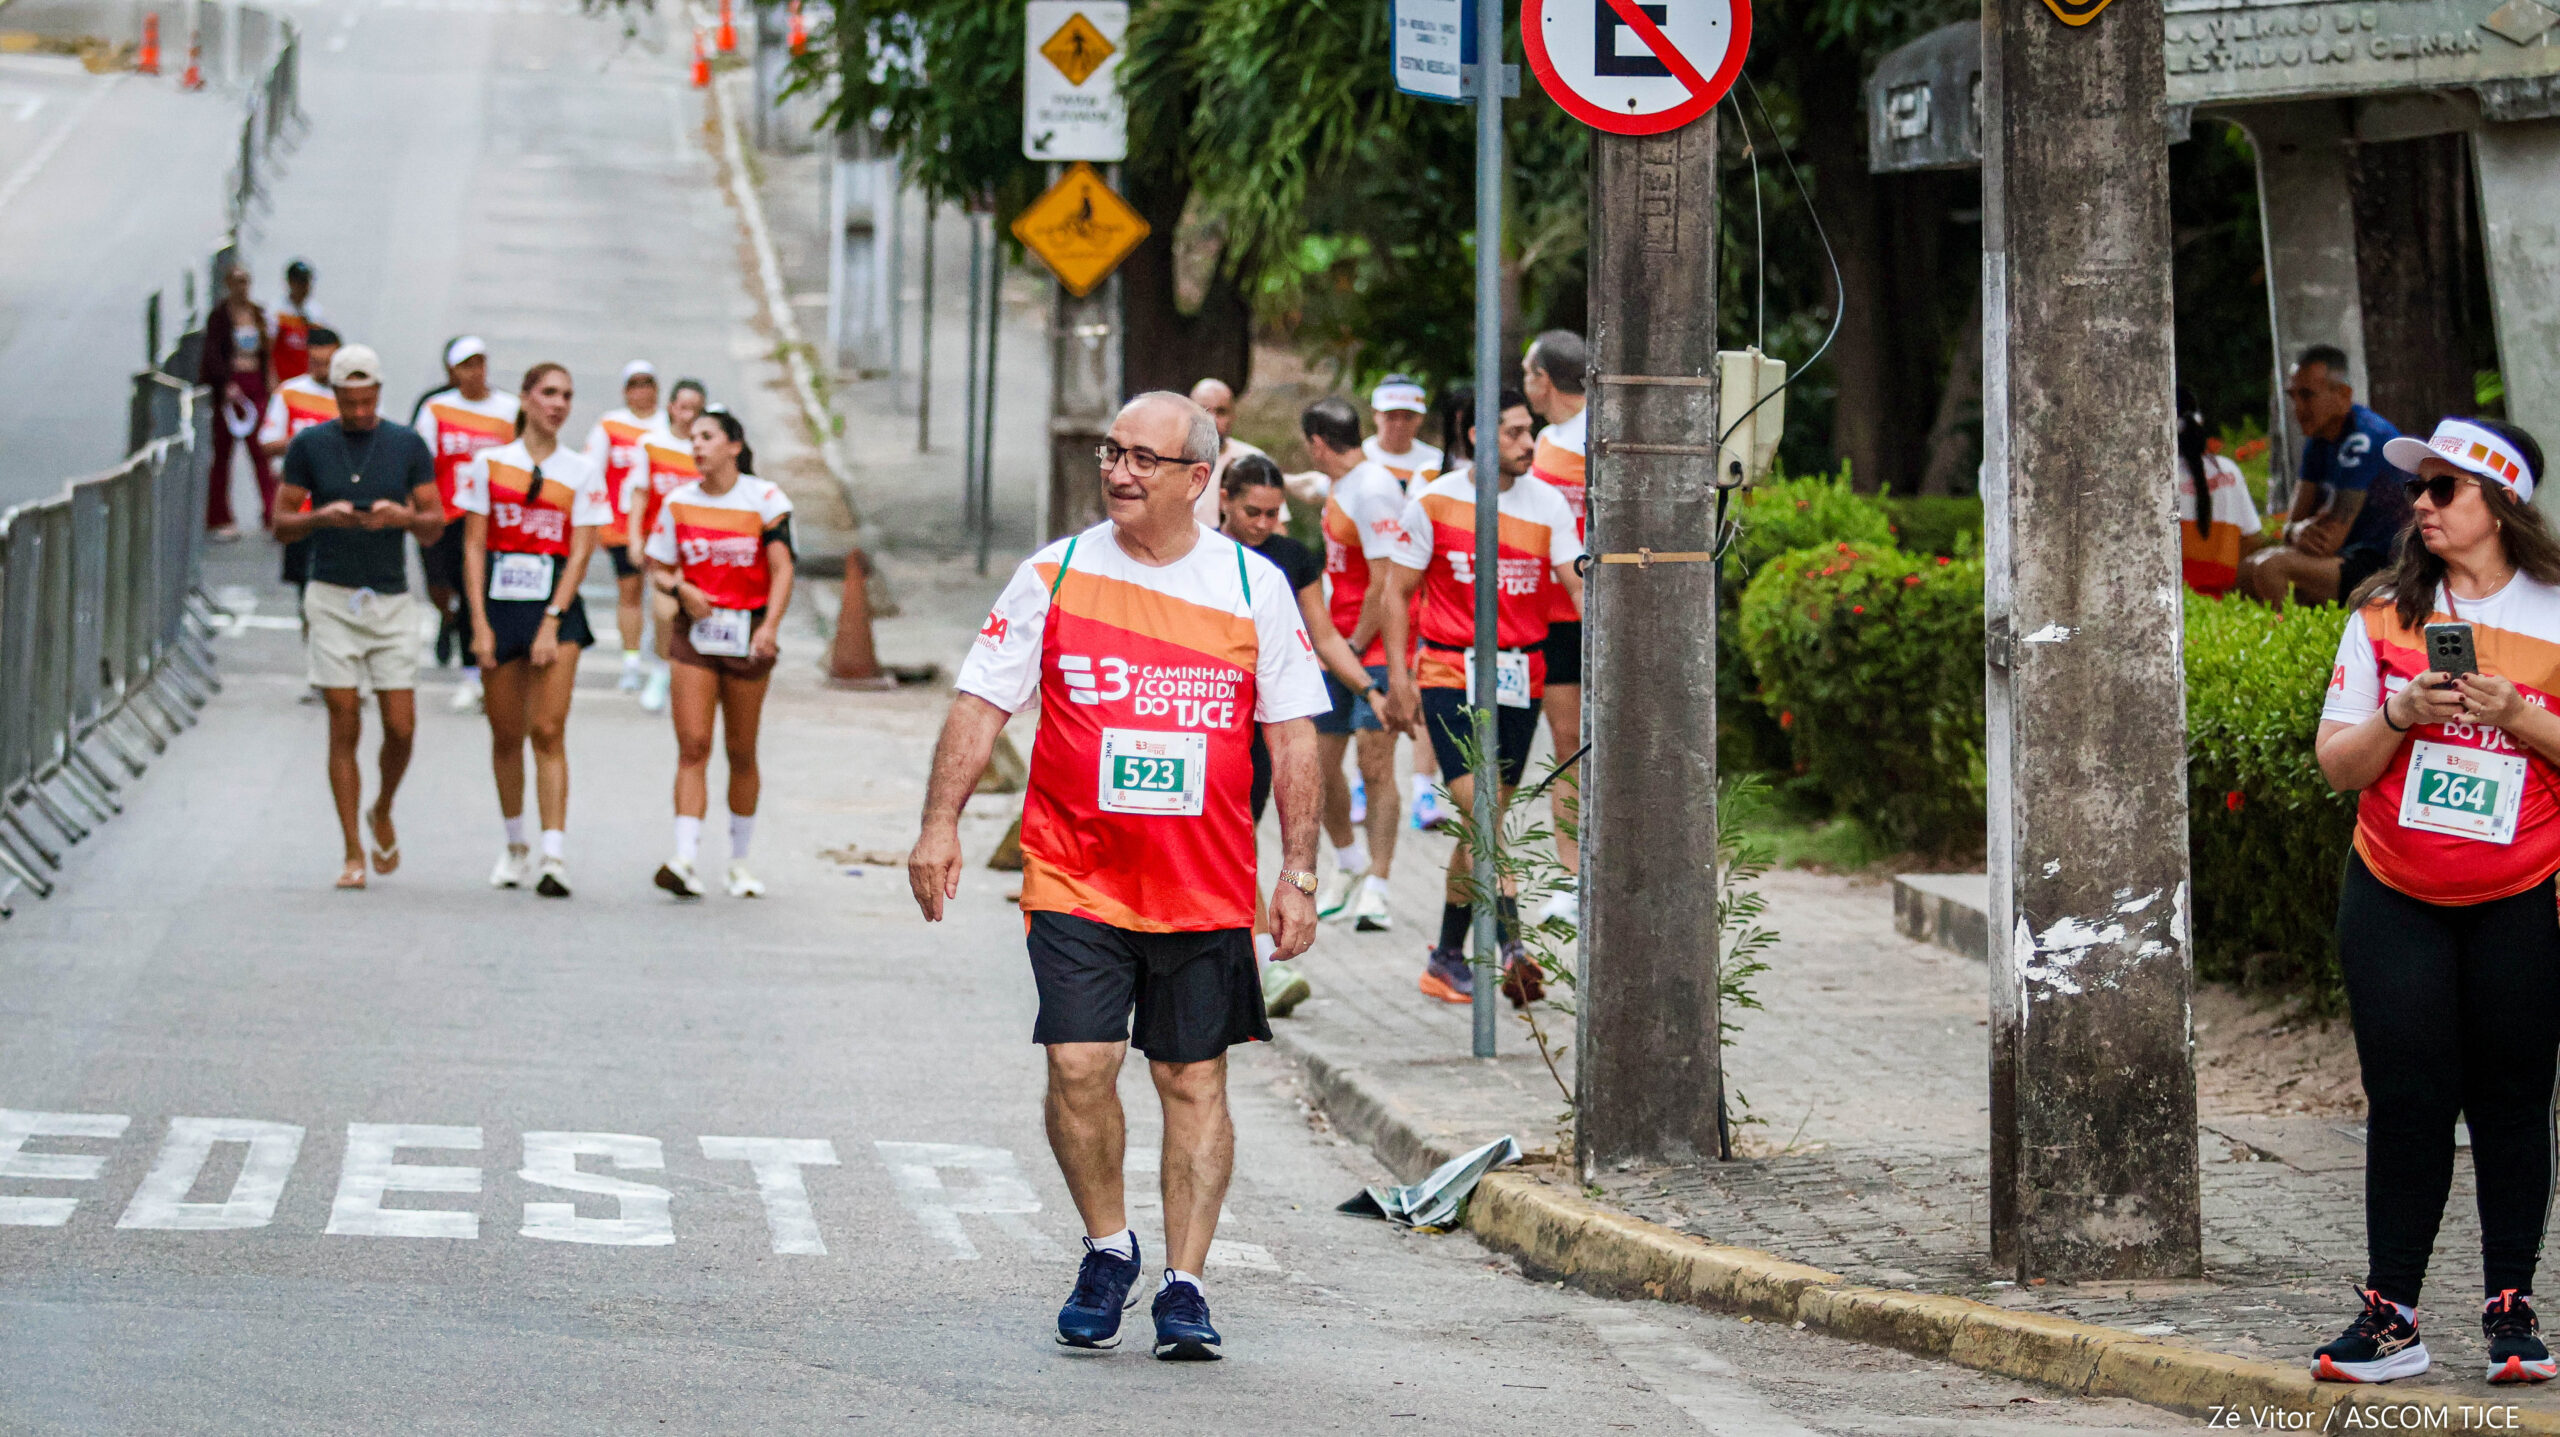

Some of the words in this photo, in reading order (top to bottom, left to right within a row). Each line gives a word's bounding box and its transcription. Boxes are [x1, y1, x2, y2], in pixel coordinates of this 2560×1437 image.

[1142, 665, 1243, 683] CAMINHADA
[1135, 696, 1169, 716] DO
[1173, 699, 1234, 729] TJCE
[2443, 722, 2474, 740] DO
[2478, 726, 2516, 750] TJC
[1124, 758, 1175, 790] 523
[2428, 772, 2486, 811] 264
